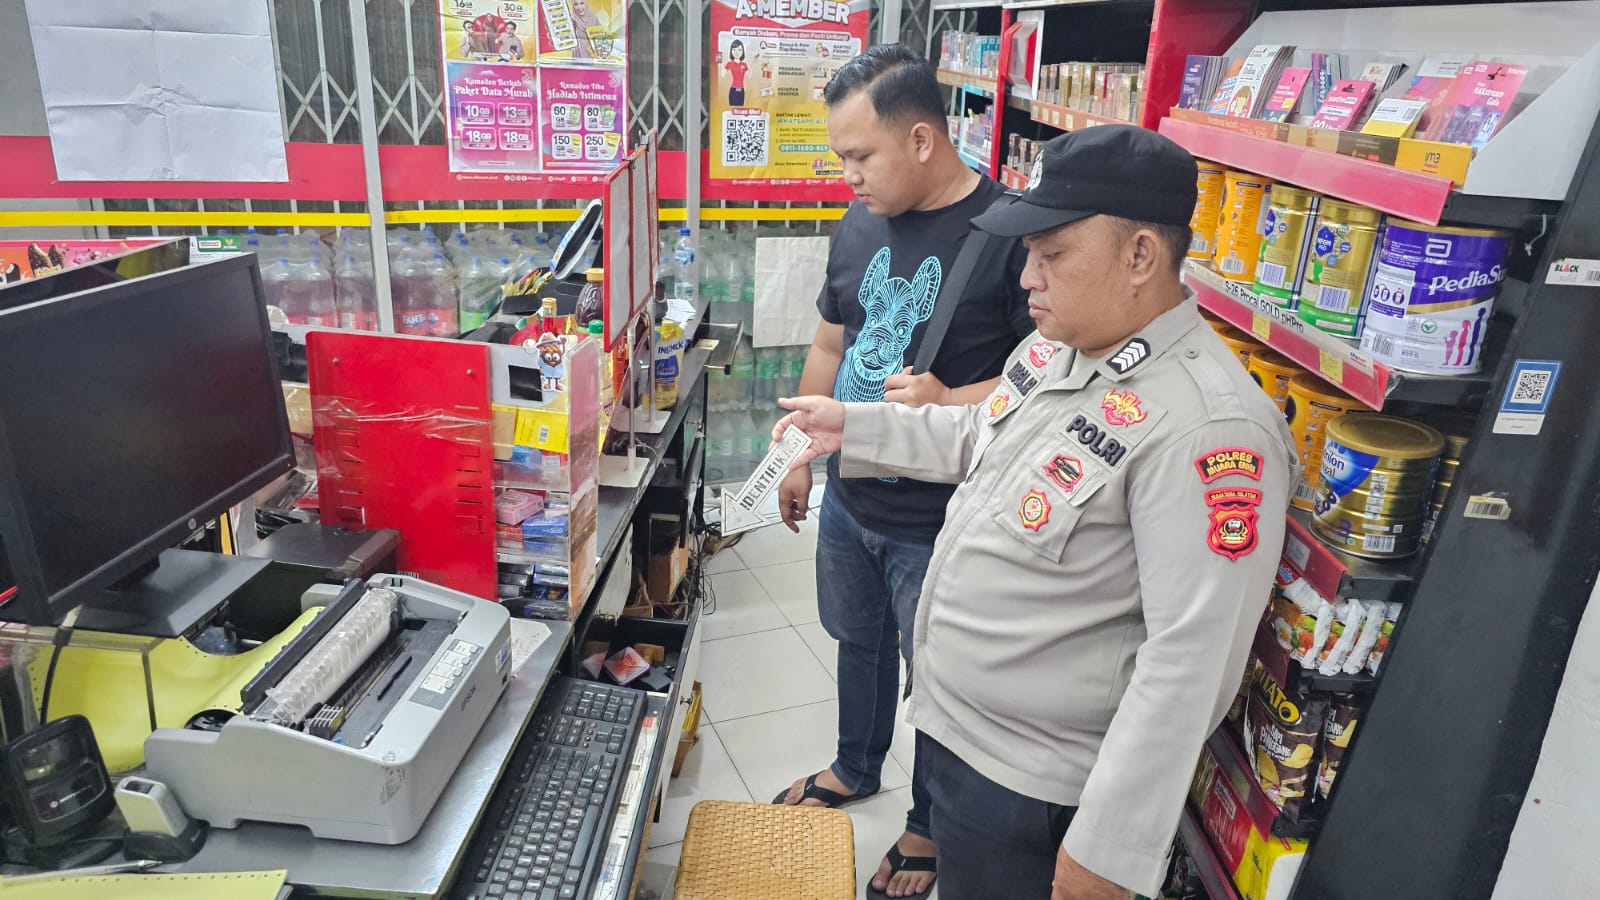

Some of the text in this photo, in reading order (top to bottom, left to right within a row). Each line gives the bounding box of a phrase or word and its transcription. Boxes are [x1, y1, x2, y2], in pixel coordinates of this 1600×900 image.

[503, 3, 515, 11] 30
[454, 86, 479, 97] Paket
[481, 87, 502, 97] Data
[553, 106, 566, 116] 60
[587, 107, 599, 117] 80
[554, 135, 570, 145] 150
[586, 135, 604, 146] 250
[1554, 263, 1580, 273] BLACK
[1428, 264, 1506, 296] PediaSu
[1225, 281, 1239, 298] S-26
[1260, 299, 1280, 319] GOLD
[1065, 414, 1127, 467] POLRI
[1206, 451, 1253, 466] POLRES
[1206, 460, 1237, 476] MUARA
